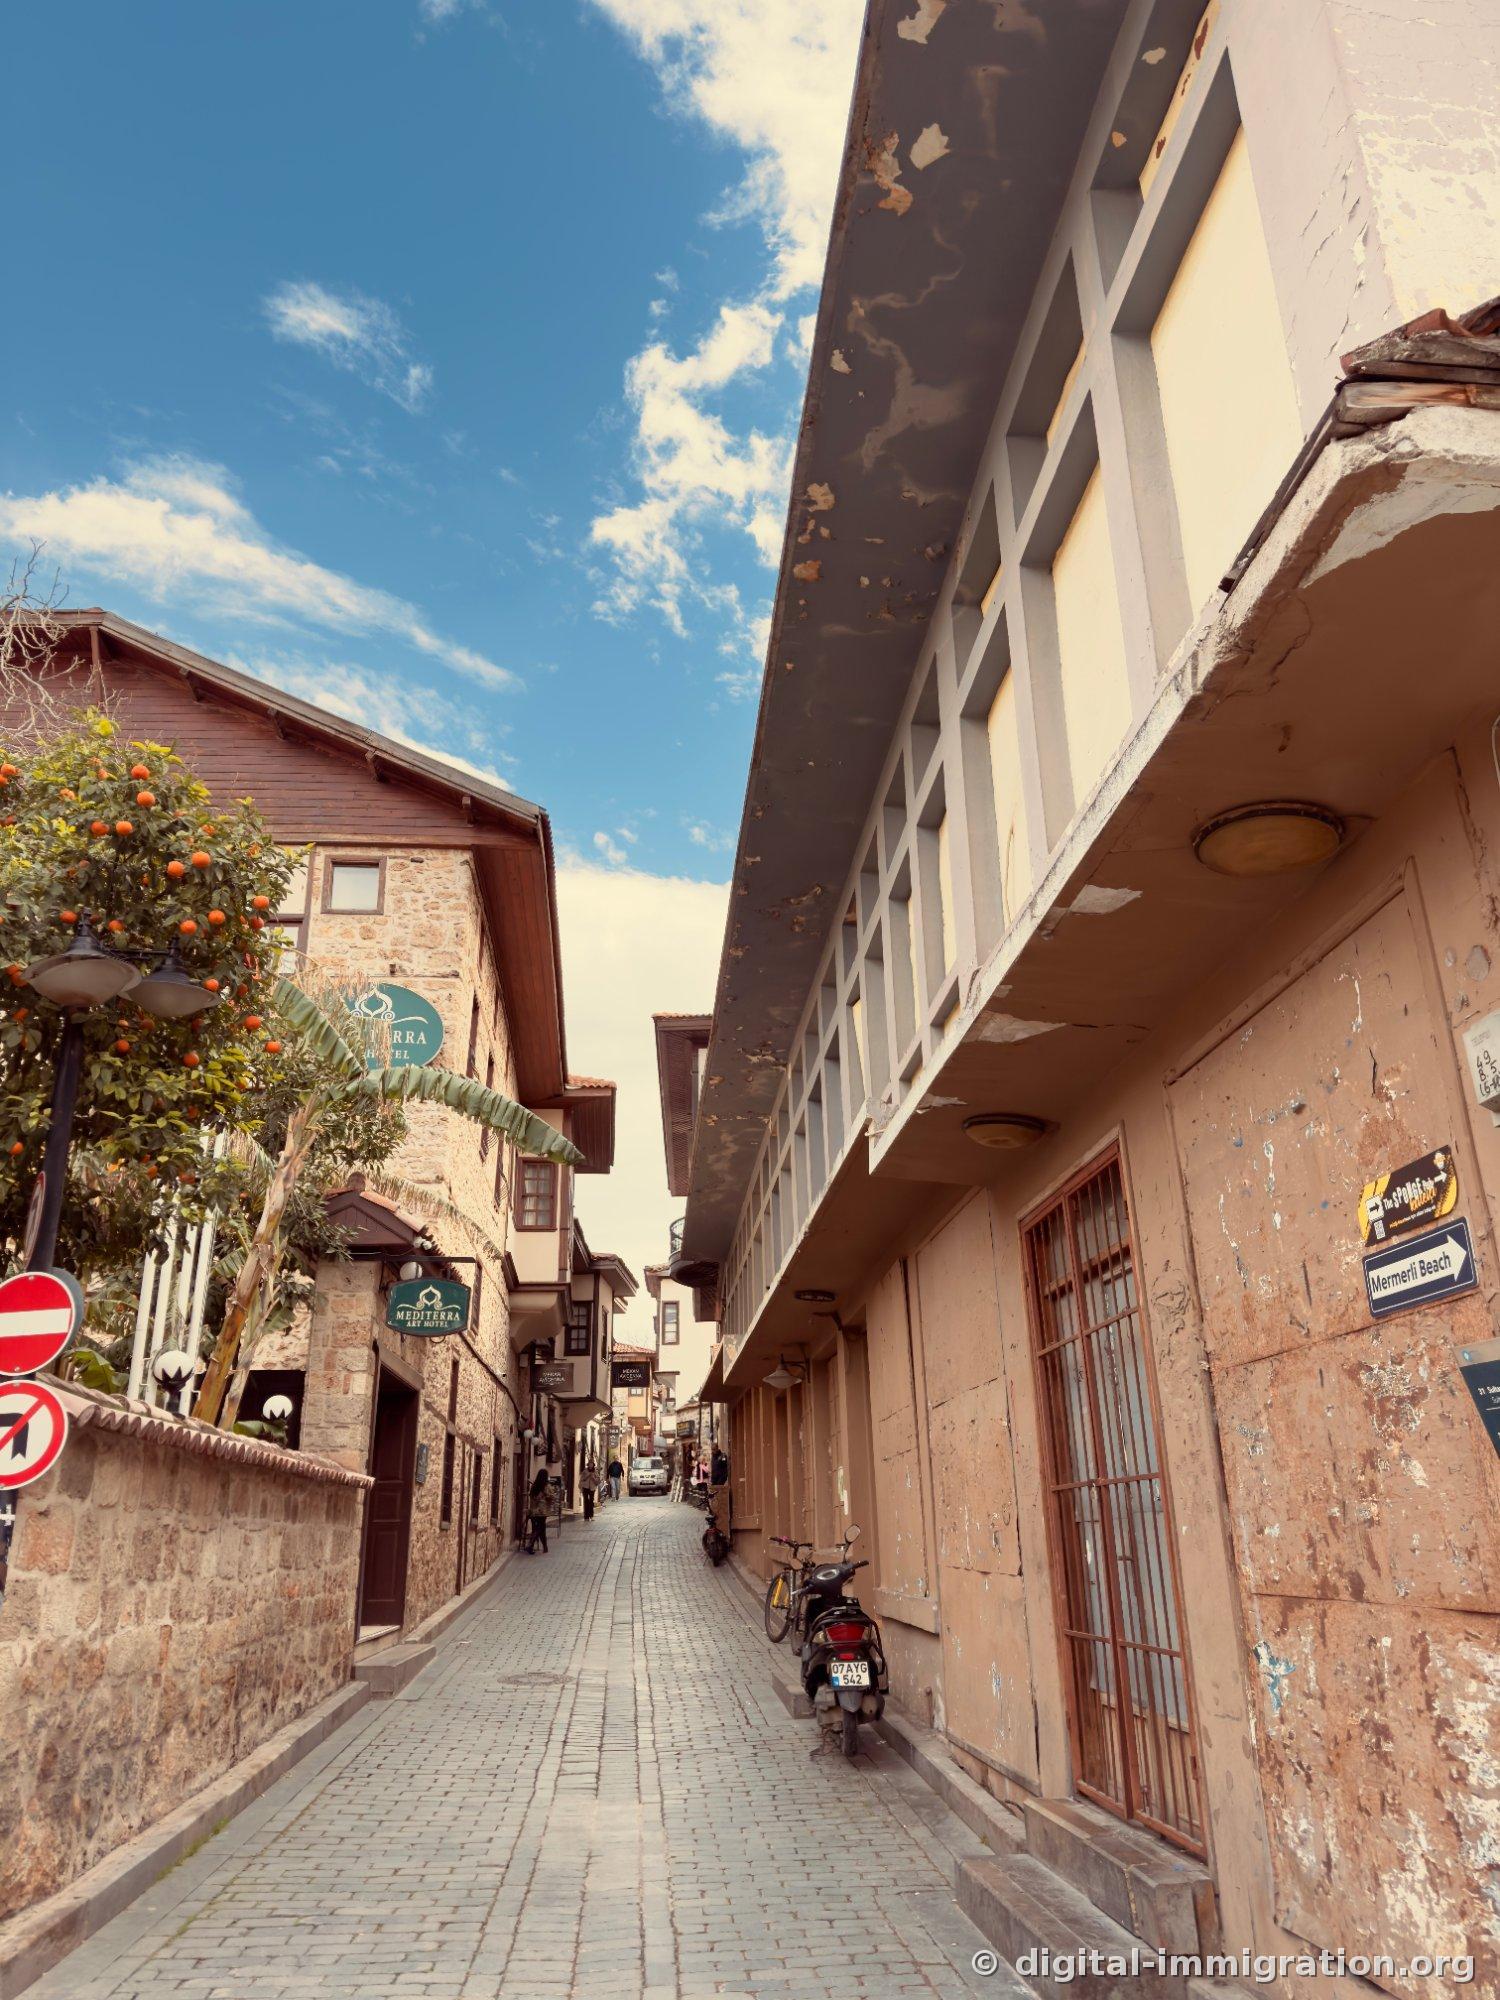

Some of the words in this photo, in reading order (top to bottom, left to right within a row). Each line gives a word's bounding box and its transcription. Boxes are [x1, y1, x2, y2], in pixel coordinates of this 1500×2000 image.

[1392, 1177, 1423, 1208] SPONGE
[1371, 1261, 1418, 1293] Mermerli
[1419, 1252, 1451, 1277] Beach
[396, 1310, 460, 1321] MEDITERRA
[842, 1674, 862, 1685] 542
